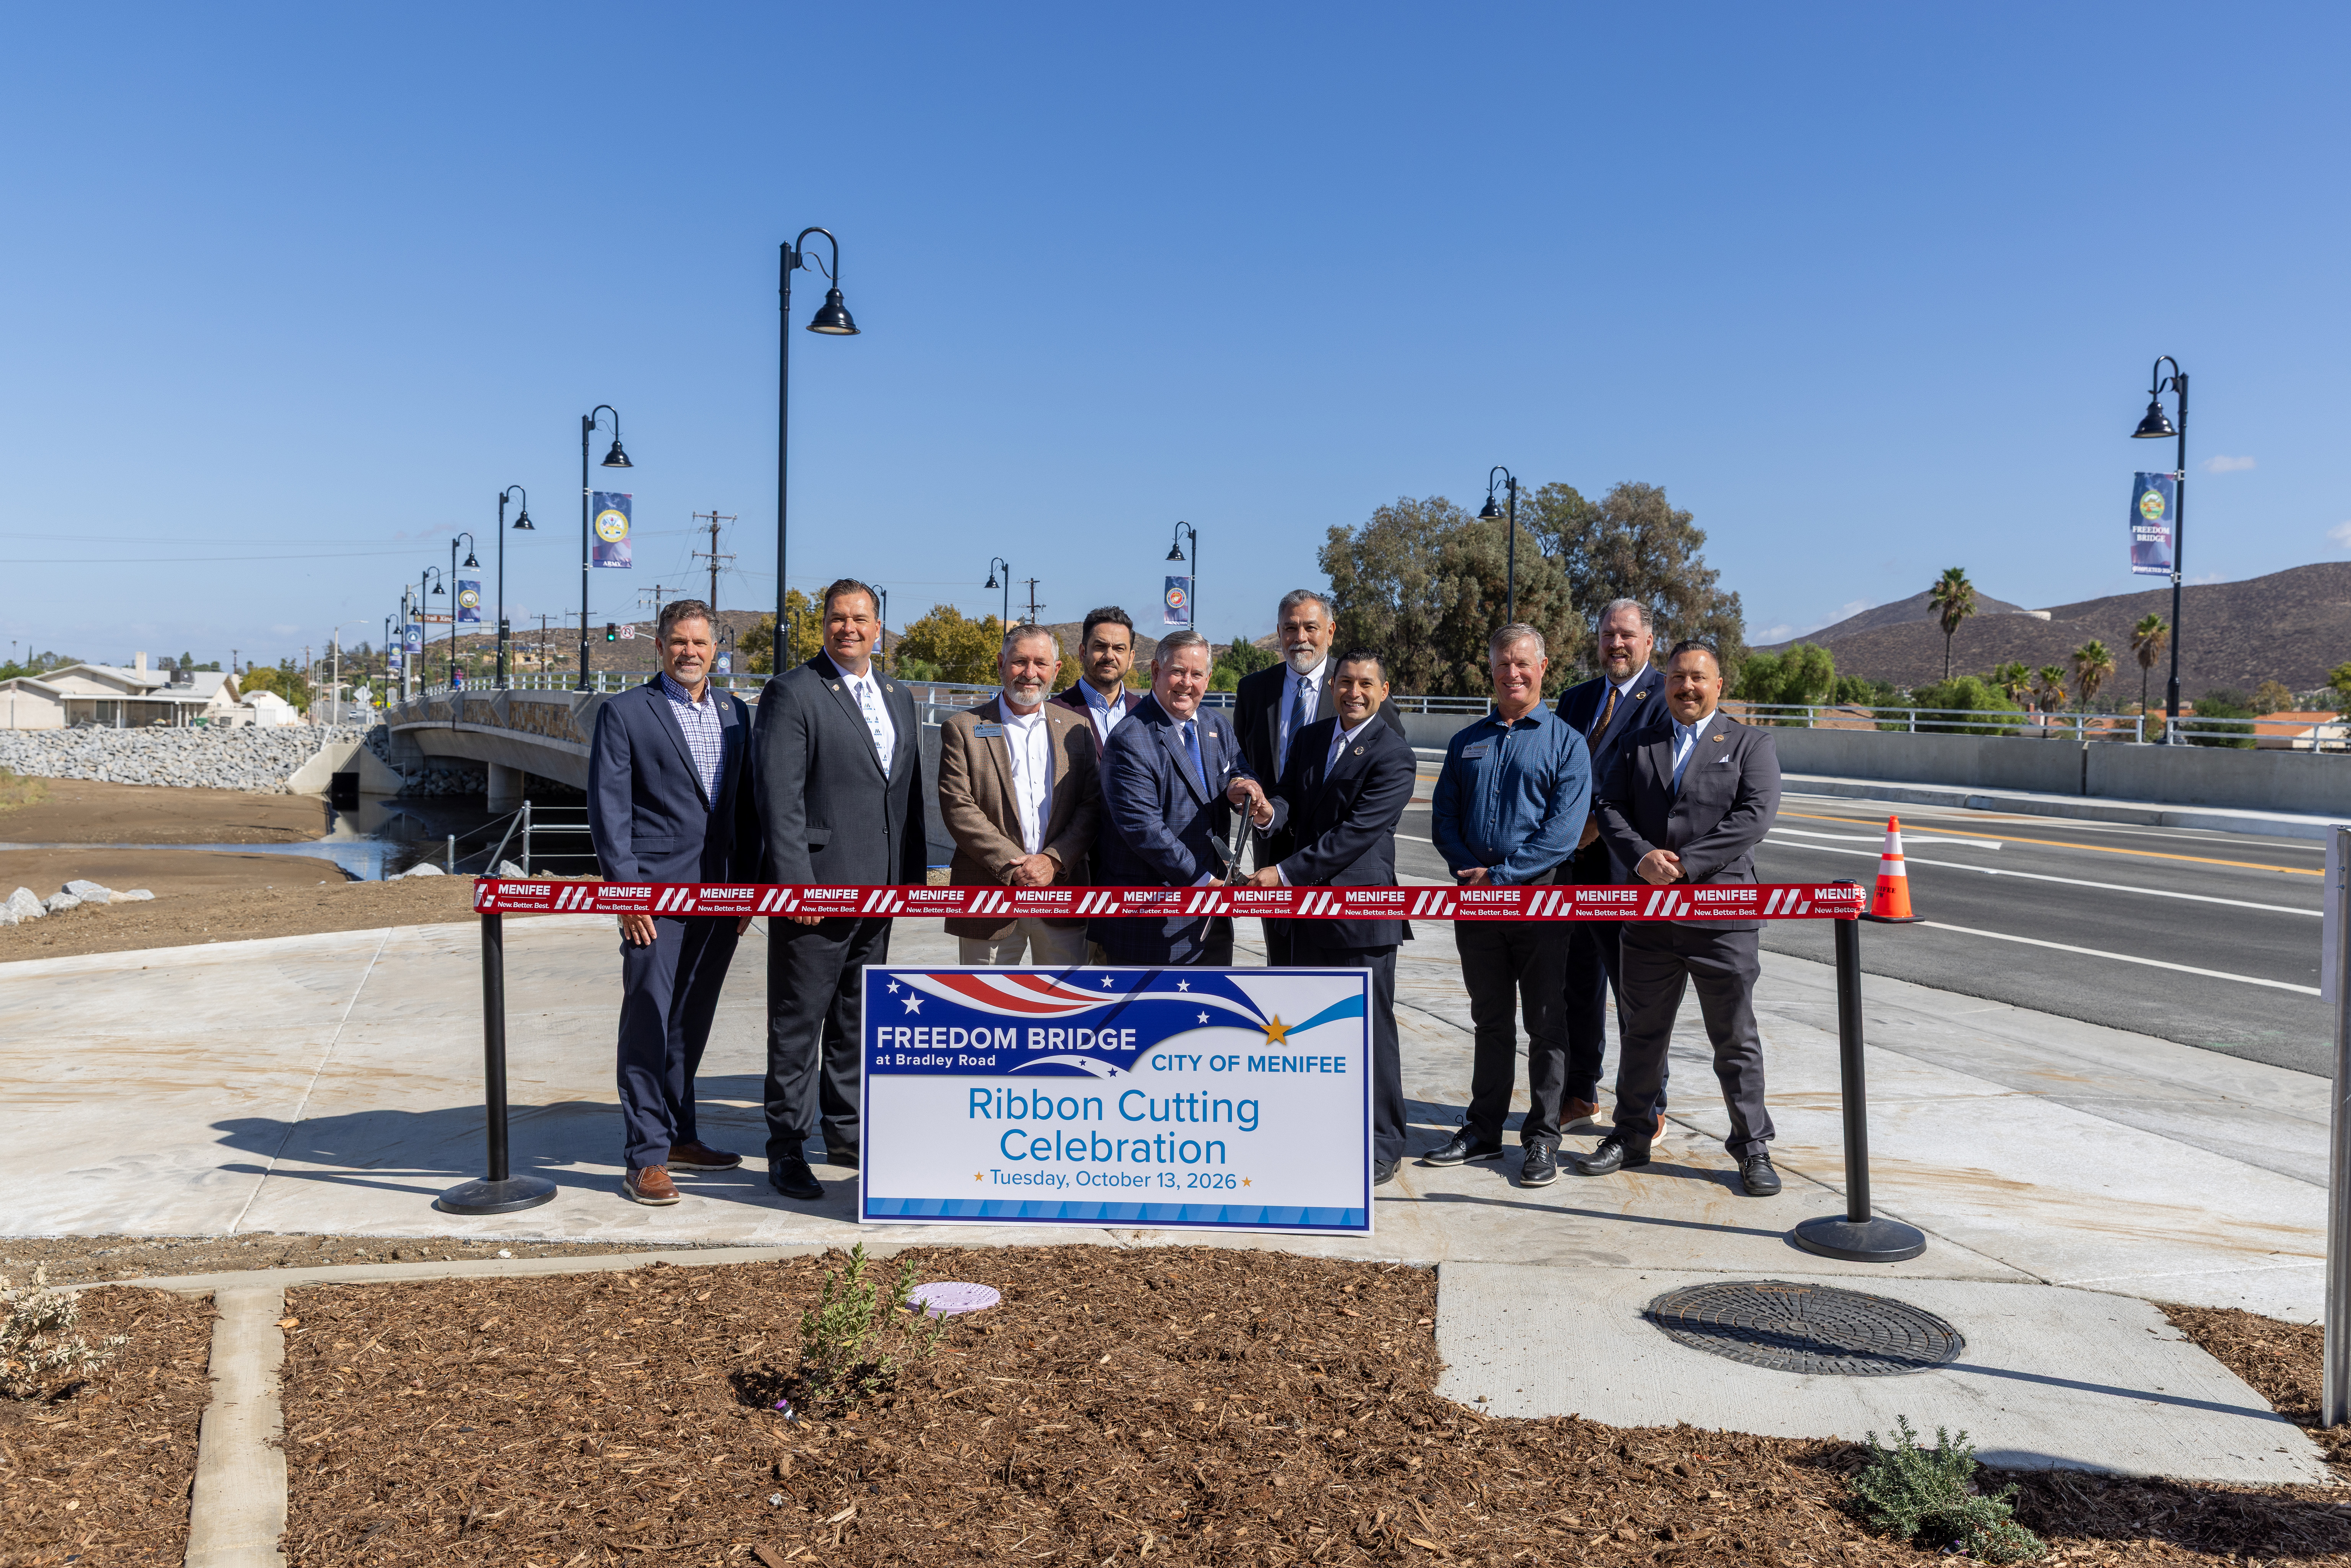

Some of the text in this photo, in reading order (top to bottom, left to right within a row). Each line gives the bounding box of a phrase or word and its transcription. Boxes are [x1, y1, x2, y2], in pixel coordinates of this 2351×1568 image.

[2133, 526, 2170, 534] FREEDOM
[2137, 534, 2165, 542] BRIDGE
[498, 884, 550, 895] MENIFEE
[598, 887, 651, 897] MENIFEE
[700, 888, 754, 898] MENIFEE
[804, 889, 858, 899] MENIFEE
[1815, 888, 1866, 900] MENIFE
[1875, 885, 1896, 893] ENIFEE
[908, 890, 964, 900] MENIFEE
[1016, 891, 1072, 901] MENIFEE
[1124, 892, 1181, 901] MENIFEE
[1234, 891, 1292, 901] MENIFEE
[1346, 892, 1405, 901] MENIFEE
[1461, 891, 1520, 901] MENIFEE
[1576, 891, 1637, 901] MENIFEE
[1694, 890, 1757, 901] MENIFEE
[878, 1027, 1135, 1050] FREEDOM BRIDGE
[876, 1054, 995, 1068] at Bradley Road
[1152, 1055, 1345, 1073] CITY OF MENIFEE
[970, 1088, 1258, 1131] Ribbon Cutting
[1001, 1130, 1225, 1164] Celebration
[990, 1169, 1236, 1190] Tuesday, October 13, 2026
